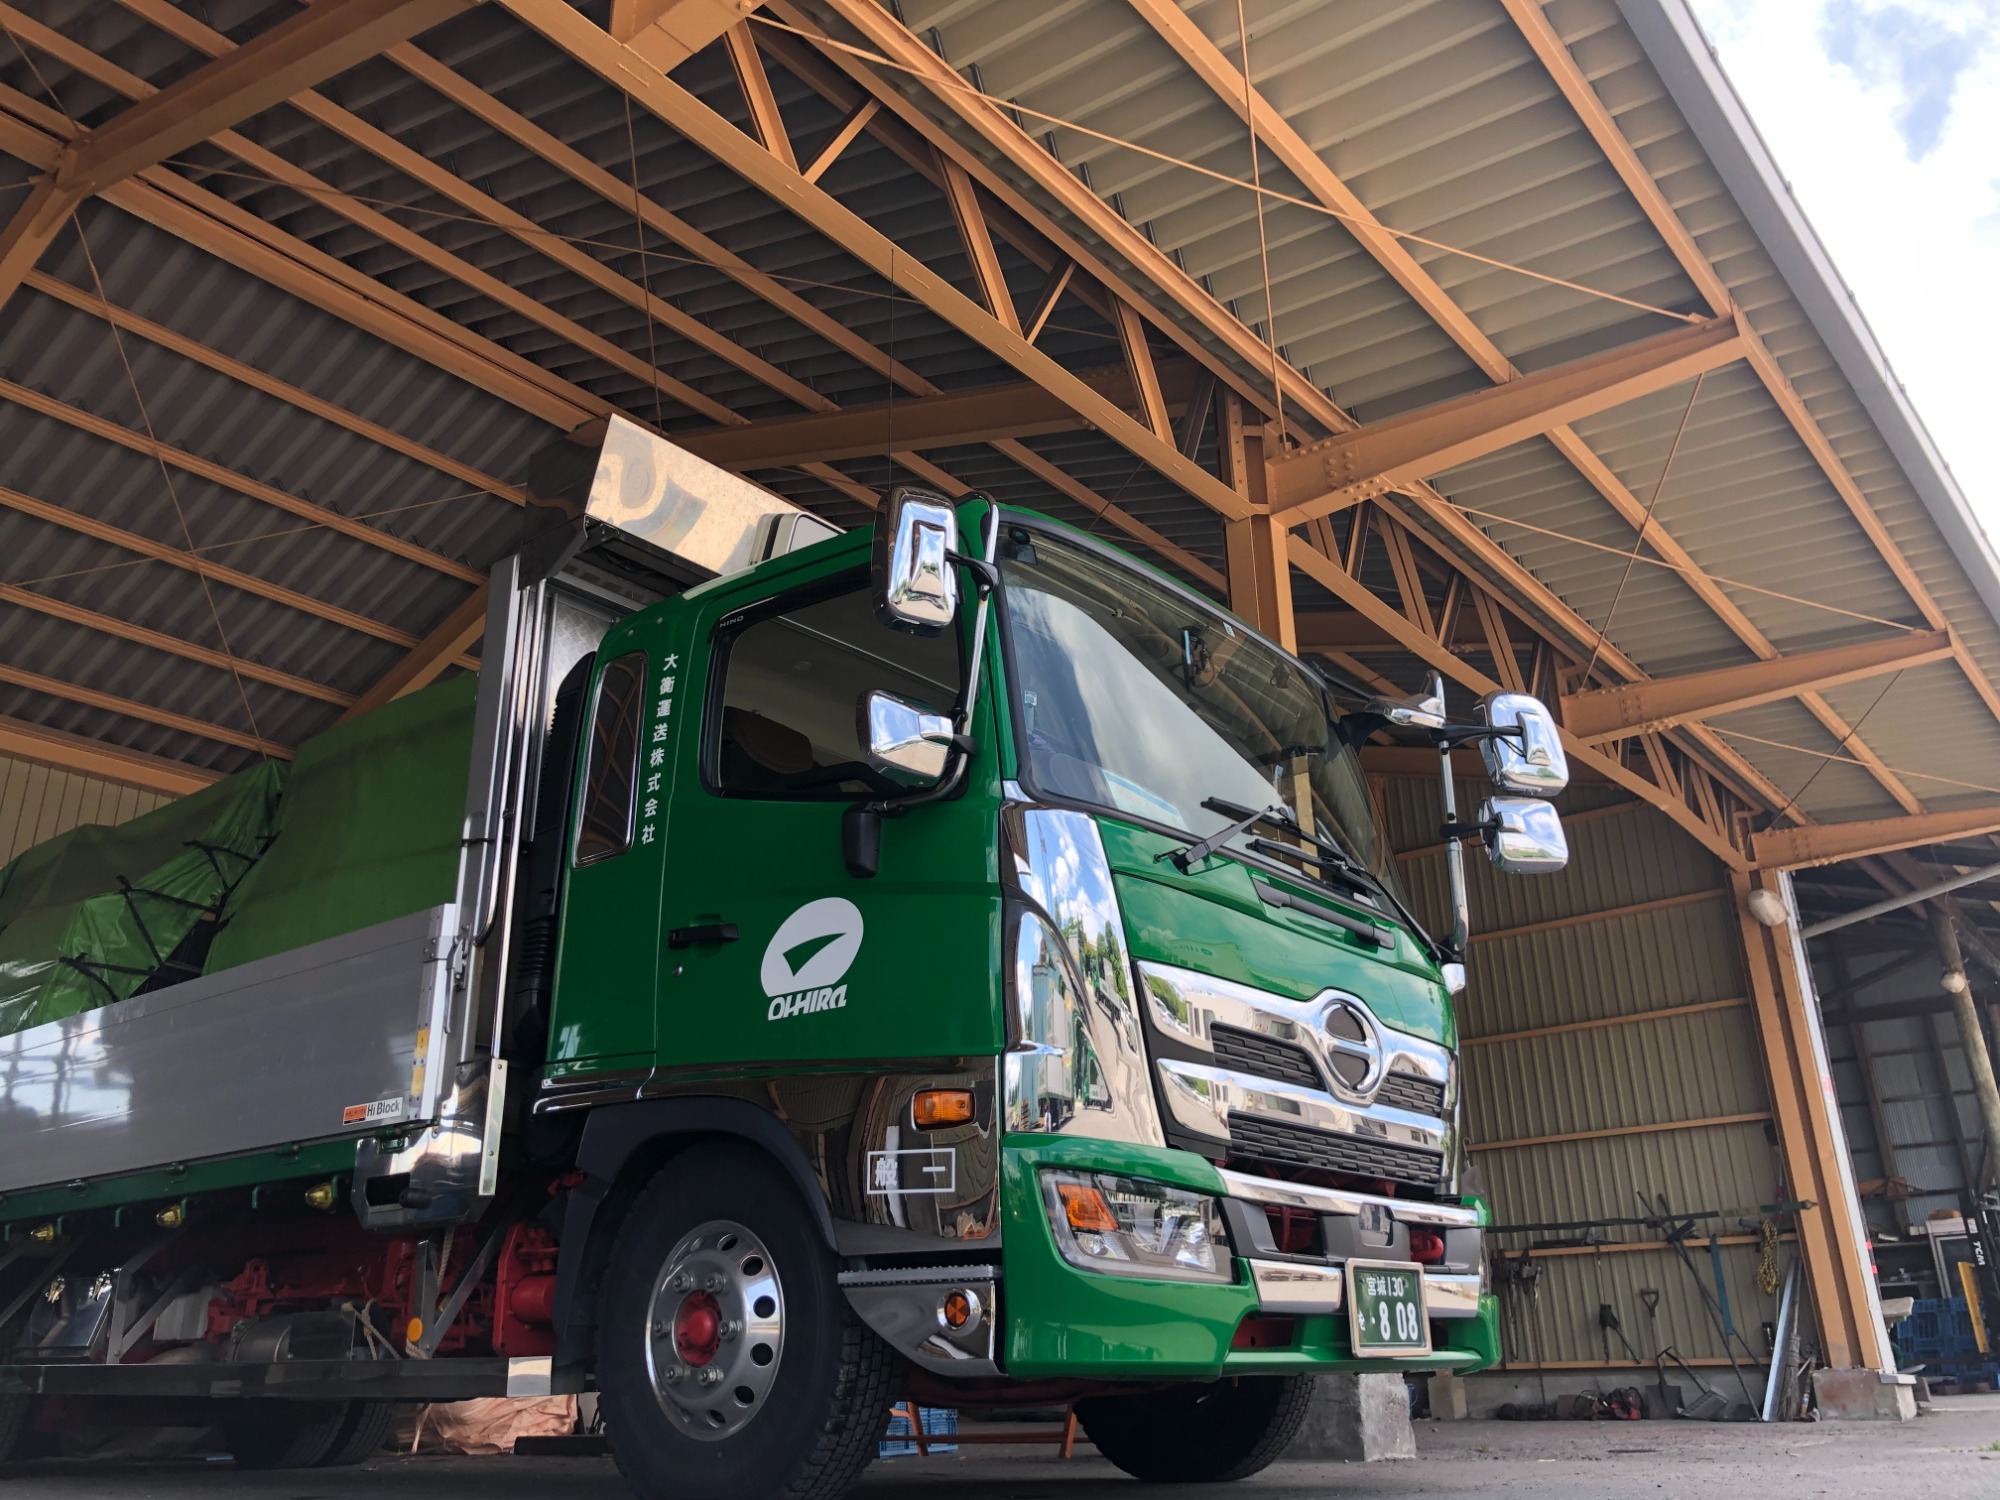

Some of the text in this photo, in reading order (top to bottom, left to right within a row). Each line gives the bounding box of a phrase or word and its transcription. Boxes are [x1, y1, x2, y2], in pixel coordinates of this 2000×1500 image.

[720, 615, 744, 628] HINO
[367, 1103, 376, 1117] Hi
[376, 1100, 400, 1115] Block
[1973, 1241, 1985, 1265] TCM
